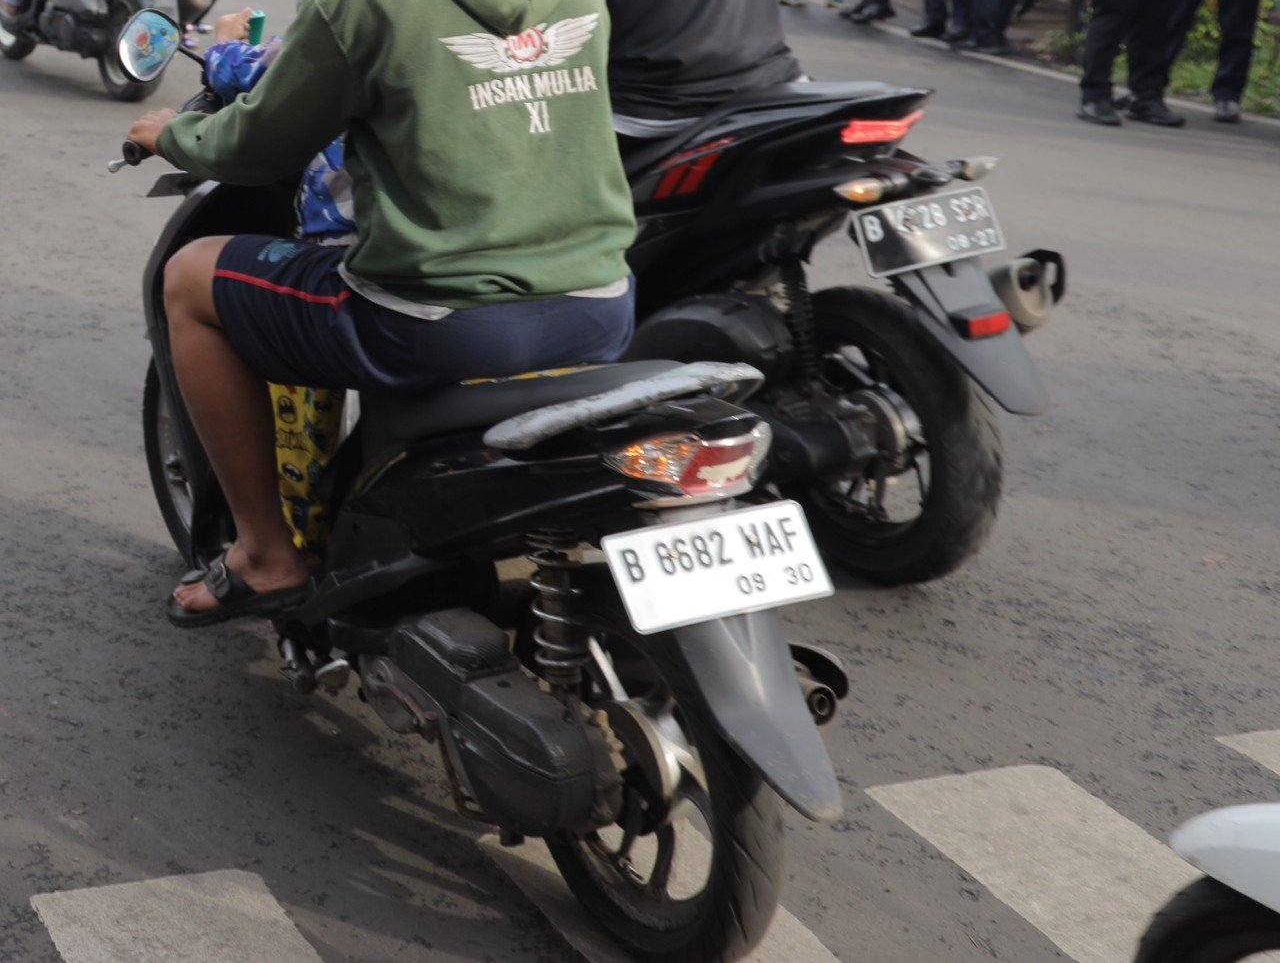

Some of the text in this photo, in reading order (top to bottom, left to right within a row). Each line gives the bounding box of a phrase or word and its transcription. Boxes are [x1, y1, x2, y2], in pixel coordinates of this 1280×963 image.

[468, 66, 598, 110] INSAN MULIA
[524, 100, 551, 133] XI
[862, 215, 885, 242] B
[620, 548, 645, 582] B
[784, 563, 815, 585] 30
